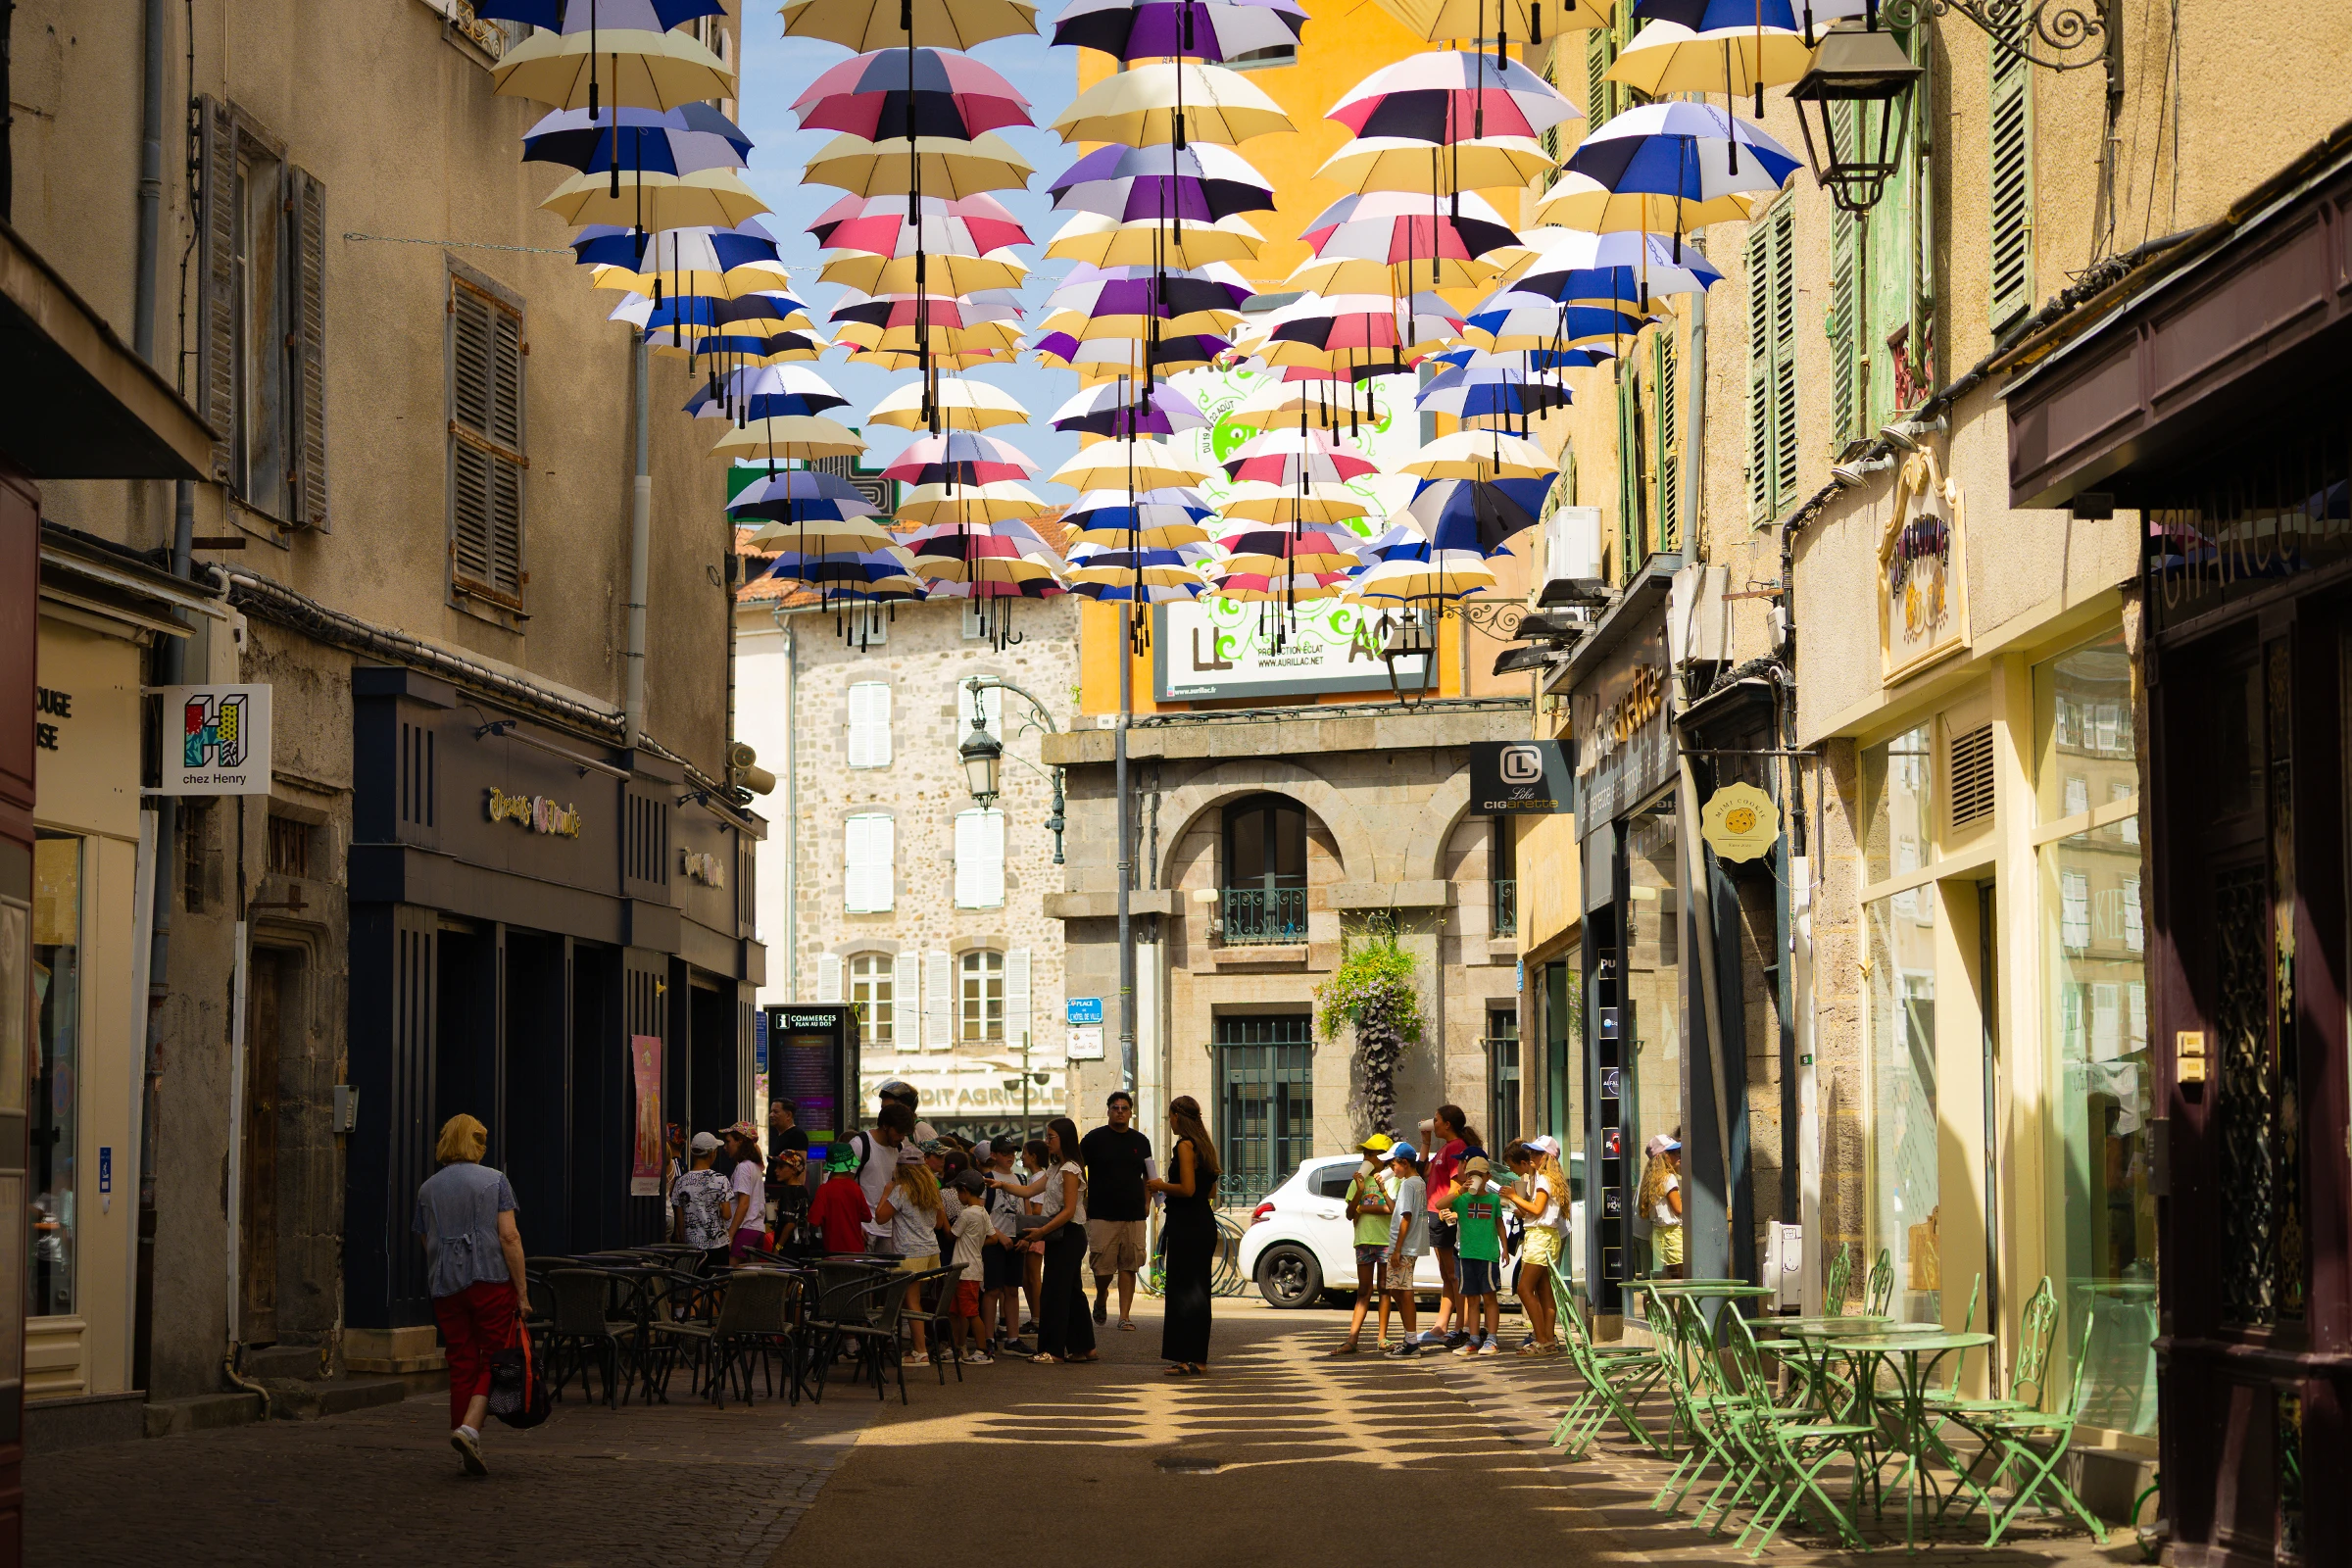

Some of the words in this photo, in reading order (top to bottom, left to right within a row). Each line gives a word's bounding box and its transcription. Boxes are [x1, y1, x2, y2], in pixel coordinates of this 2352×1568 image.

[1202, 442, 1211, 454] DU
[1209, 412, 1219, 422] 22
[1216, 400, 1235, 416] AOÛT
[1257, 646, 1301, 657] PROCTION
[1302, 643, 1324, 655] ÉCLAT
[1257, 656, 1324, 668] WWW.AURILLAC.NET
[1174, 686, 1217, 696] www.aurillac.fr
[182, 773, 210, 785] chez
[213, 773, 247, 786] Henry
[1508, 786, 1536, 801] Like
[1715, 800, 1734, 818] MIMI
[957, 1087, 1065, 1105] AGRICOLE
